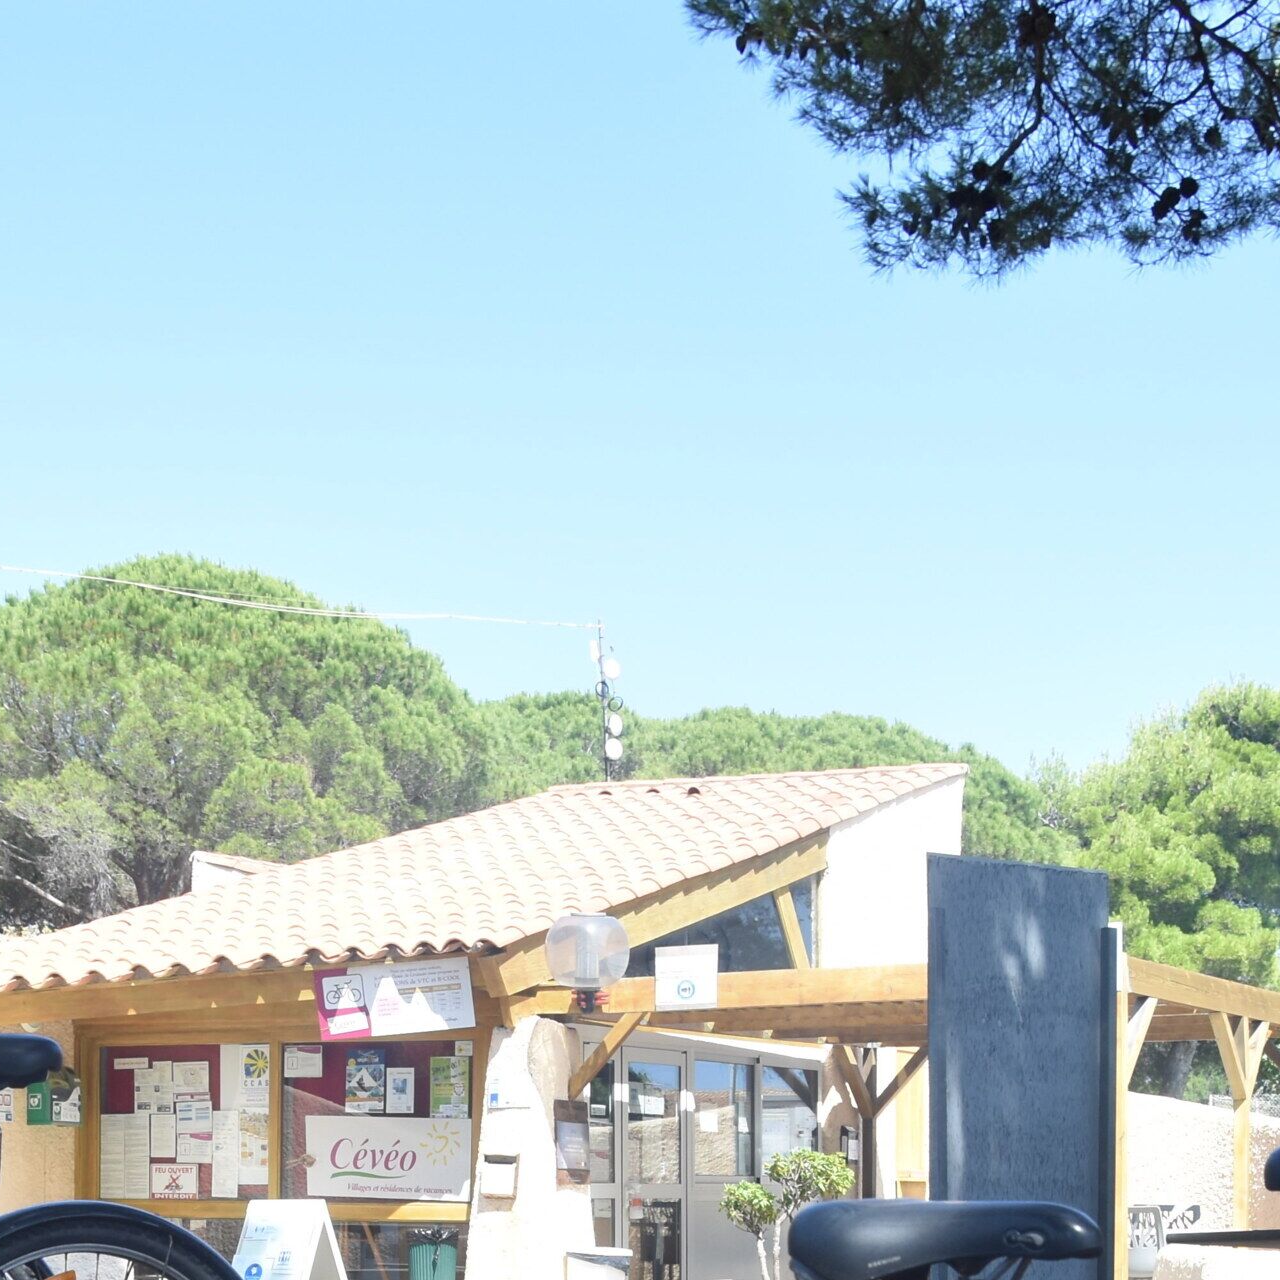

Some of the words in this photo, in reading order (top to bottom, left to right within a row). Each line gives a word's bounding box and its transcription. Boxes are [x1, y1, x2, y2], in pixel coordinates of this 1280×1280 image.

[330, 1138, 417, 1172] Cévéo
[347, 1183, 372, 1193] Villages
[373, 1184, 379, 1192] et
[380, 1183, 413, 1193] résidences
[414, 1184, 422, 1193] de
